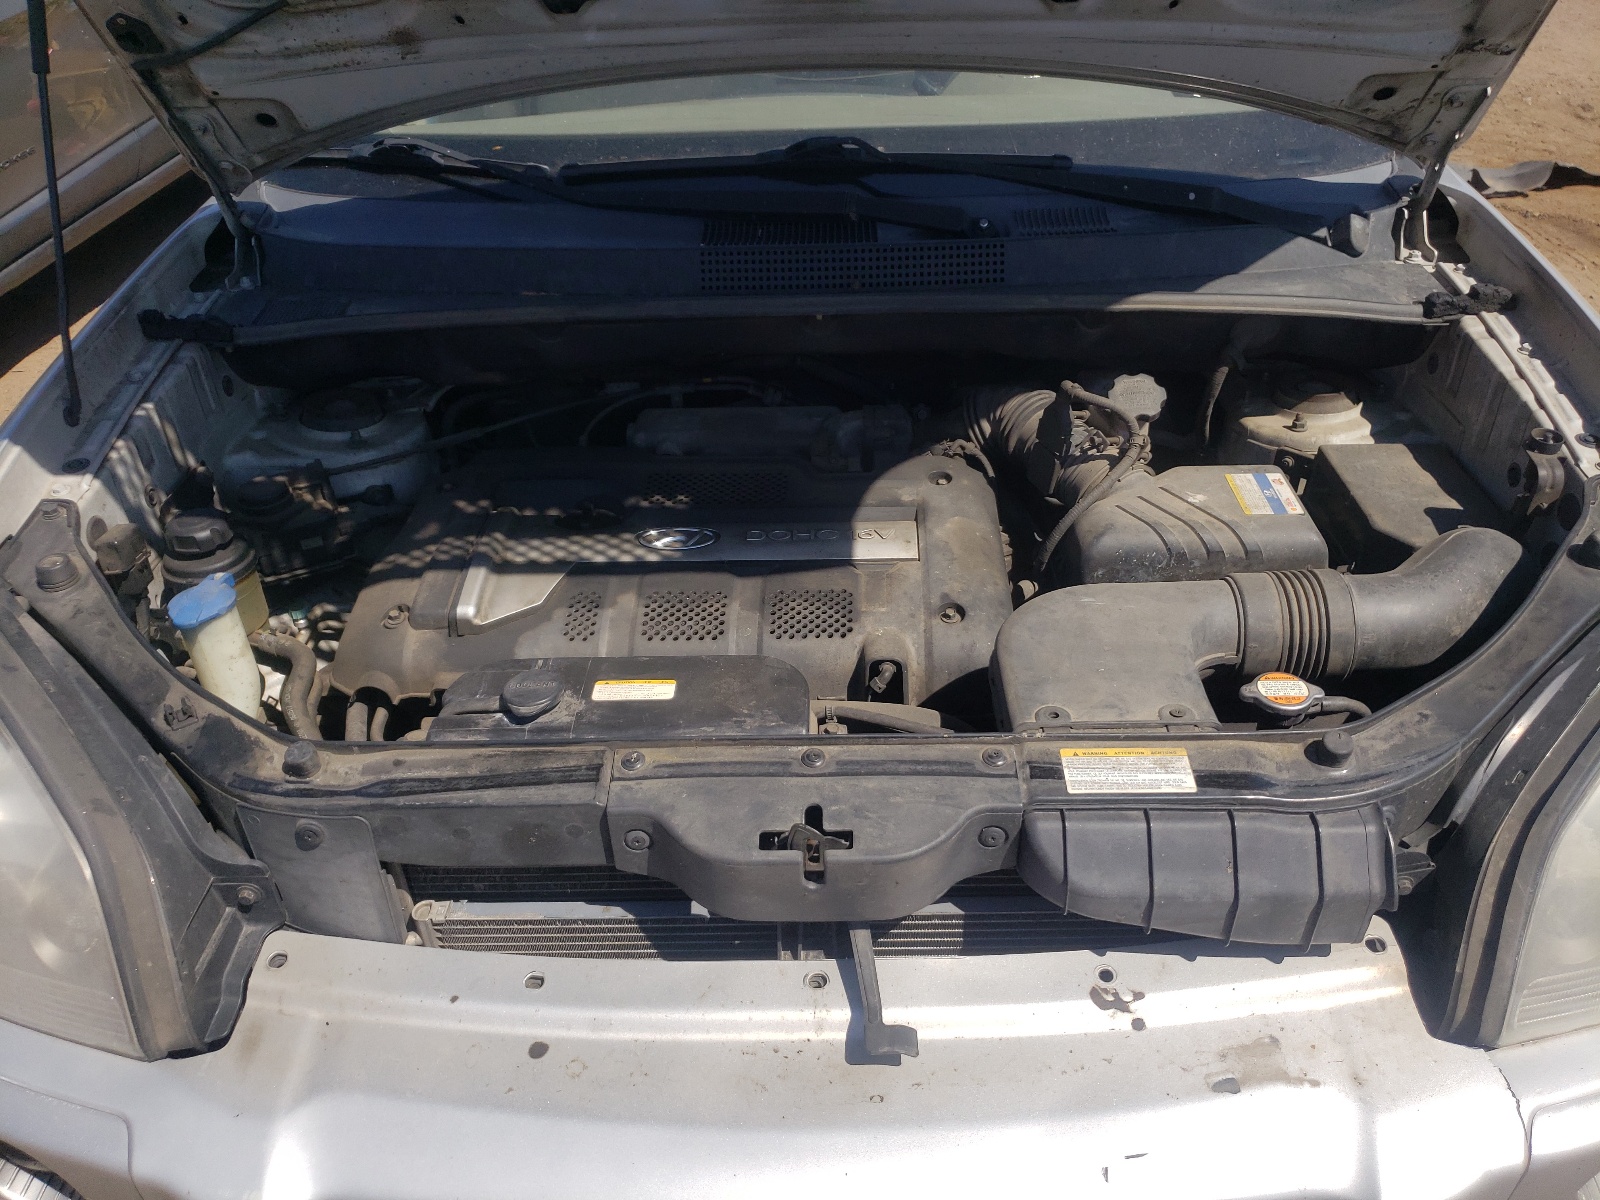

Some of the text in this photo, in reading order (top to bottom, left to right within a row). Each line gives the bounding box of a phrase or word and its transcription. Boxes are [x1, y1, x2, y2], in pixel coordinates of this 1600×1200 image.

[0, 146, 36, 171] OKEE
[746, 528, 896, 541] DOHC 16V
